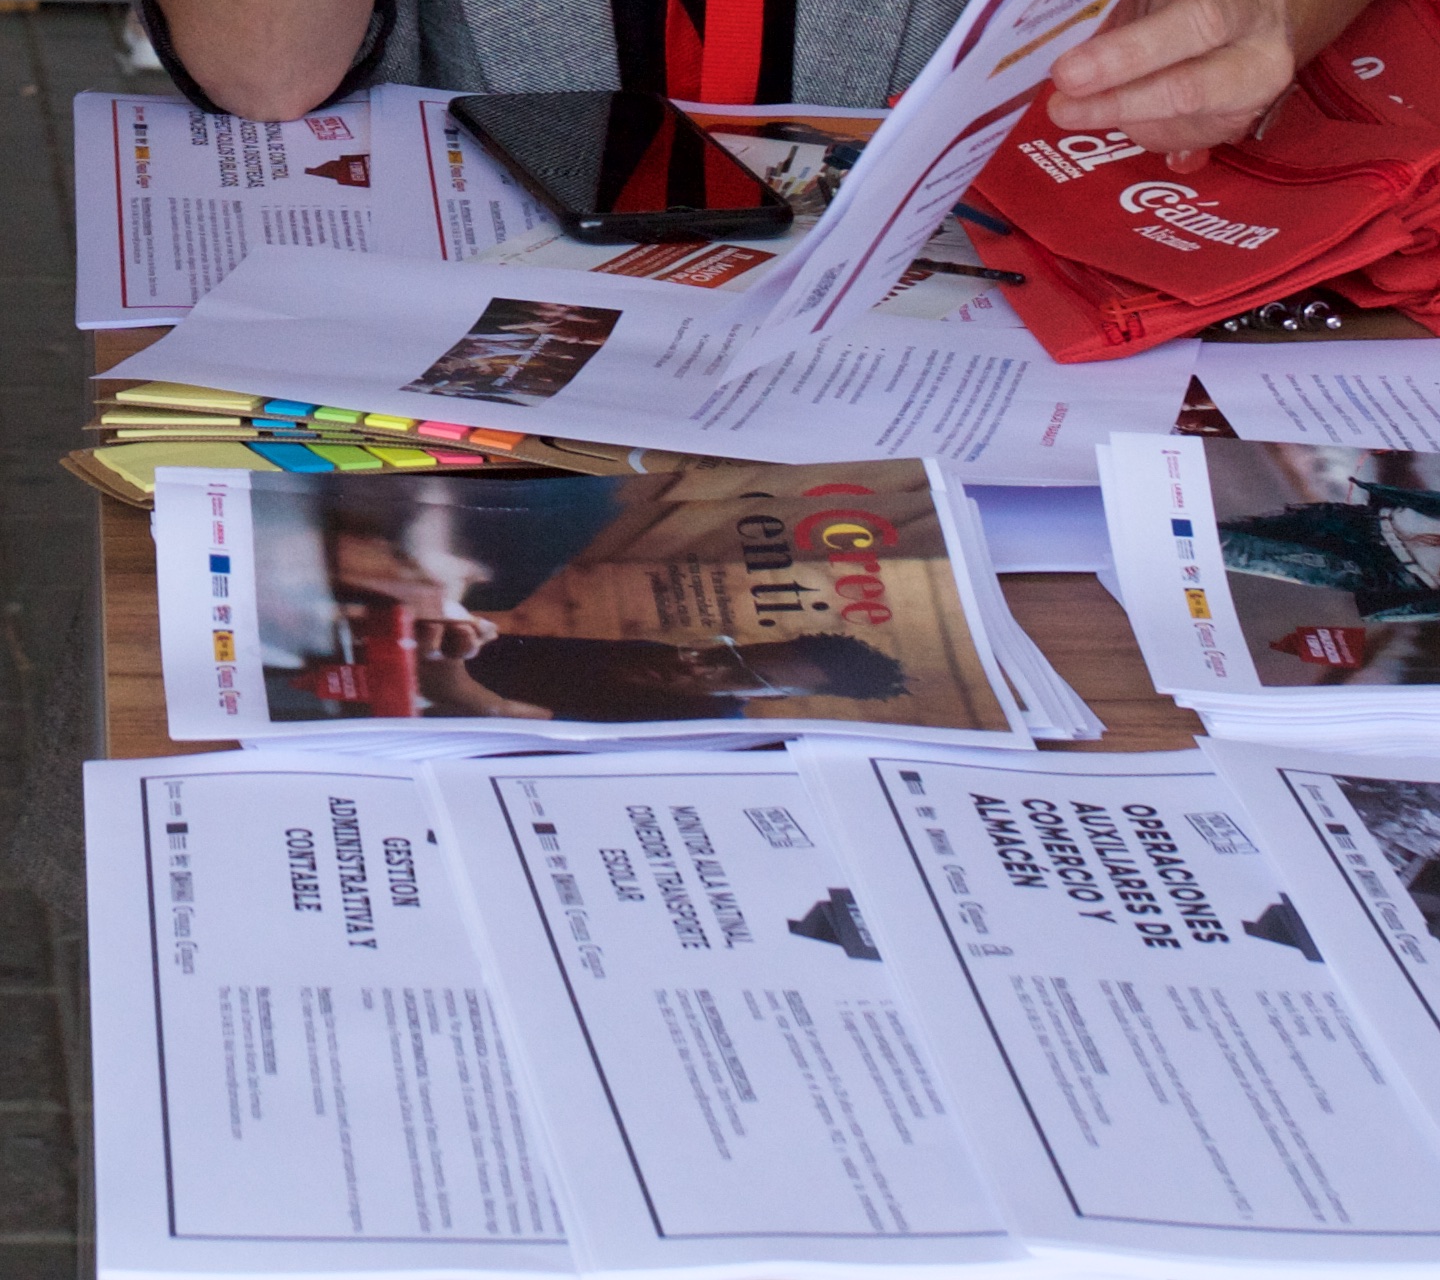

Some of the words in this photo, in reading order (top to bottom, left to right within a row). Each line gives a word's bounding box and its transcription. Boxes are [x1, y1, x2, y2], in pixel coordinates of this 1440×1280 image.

[1029, 150, 1071, 184] ALICANTE
[1031, 140, 1084, 179] DIPUTACIÓN
[1119, 180, 1280, 250] Cámara
[735, 514, 796, 574] en
[749, 580, 831, 628] ti.
[328, 795, 374, 936] ADMINISTRATIVA
[668, 804, 713, 857] MONITOR
[968, 792, 1051, 889] ALMACÉN
[1021, 798, 1099, 903] COMERCIO
[1077, 908, 1118, 925] Y
[284, 826, 323, 913] CONTABLE
[382, 836, 421, 909] GESTION
[598, 847, 645, 903] ESCOLAR
[624, 804, 669, 859] COMEDOR
[655, 870, 713, 951] TRANSPORTE
[690, 858, 727, 889] AULA
[1069, 800, 1163, 916] AUXILIARES
[1132, 921, 1183, 951] DE
[1121, 803, 1231, 944] OPERACIONES
[348, 937, 377, 951] Y
